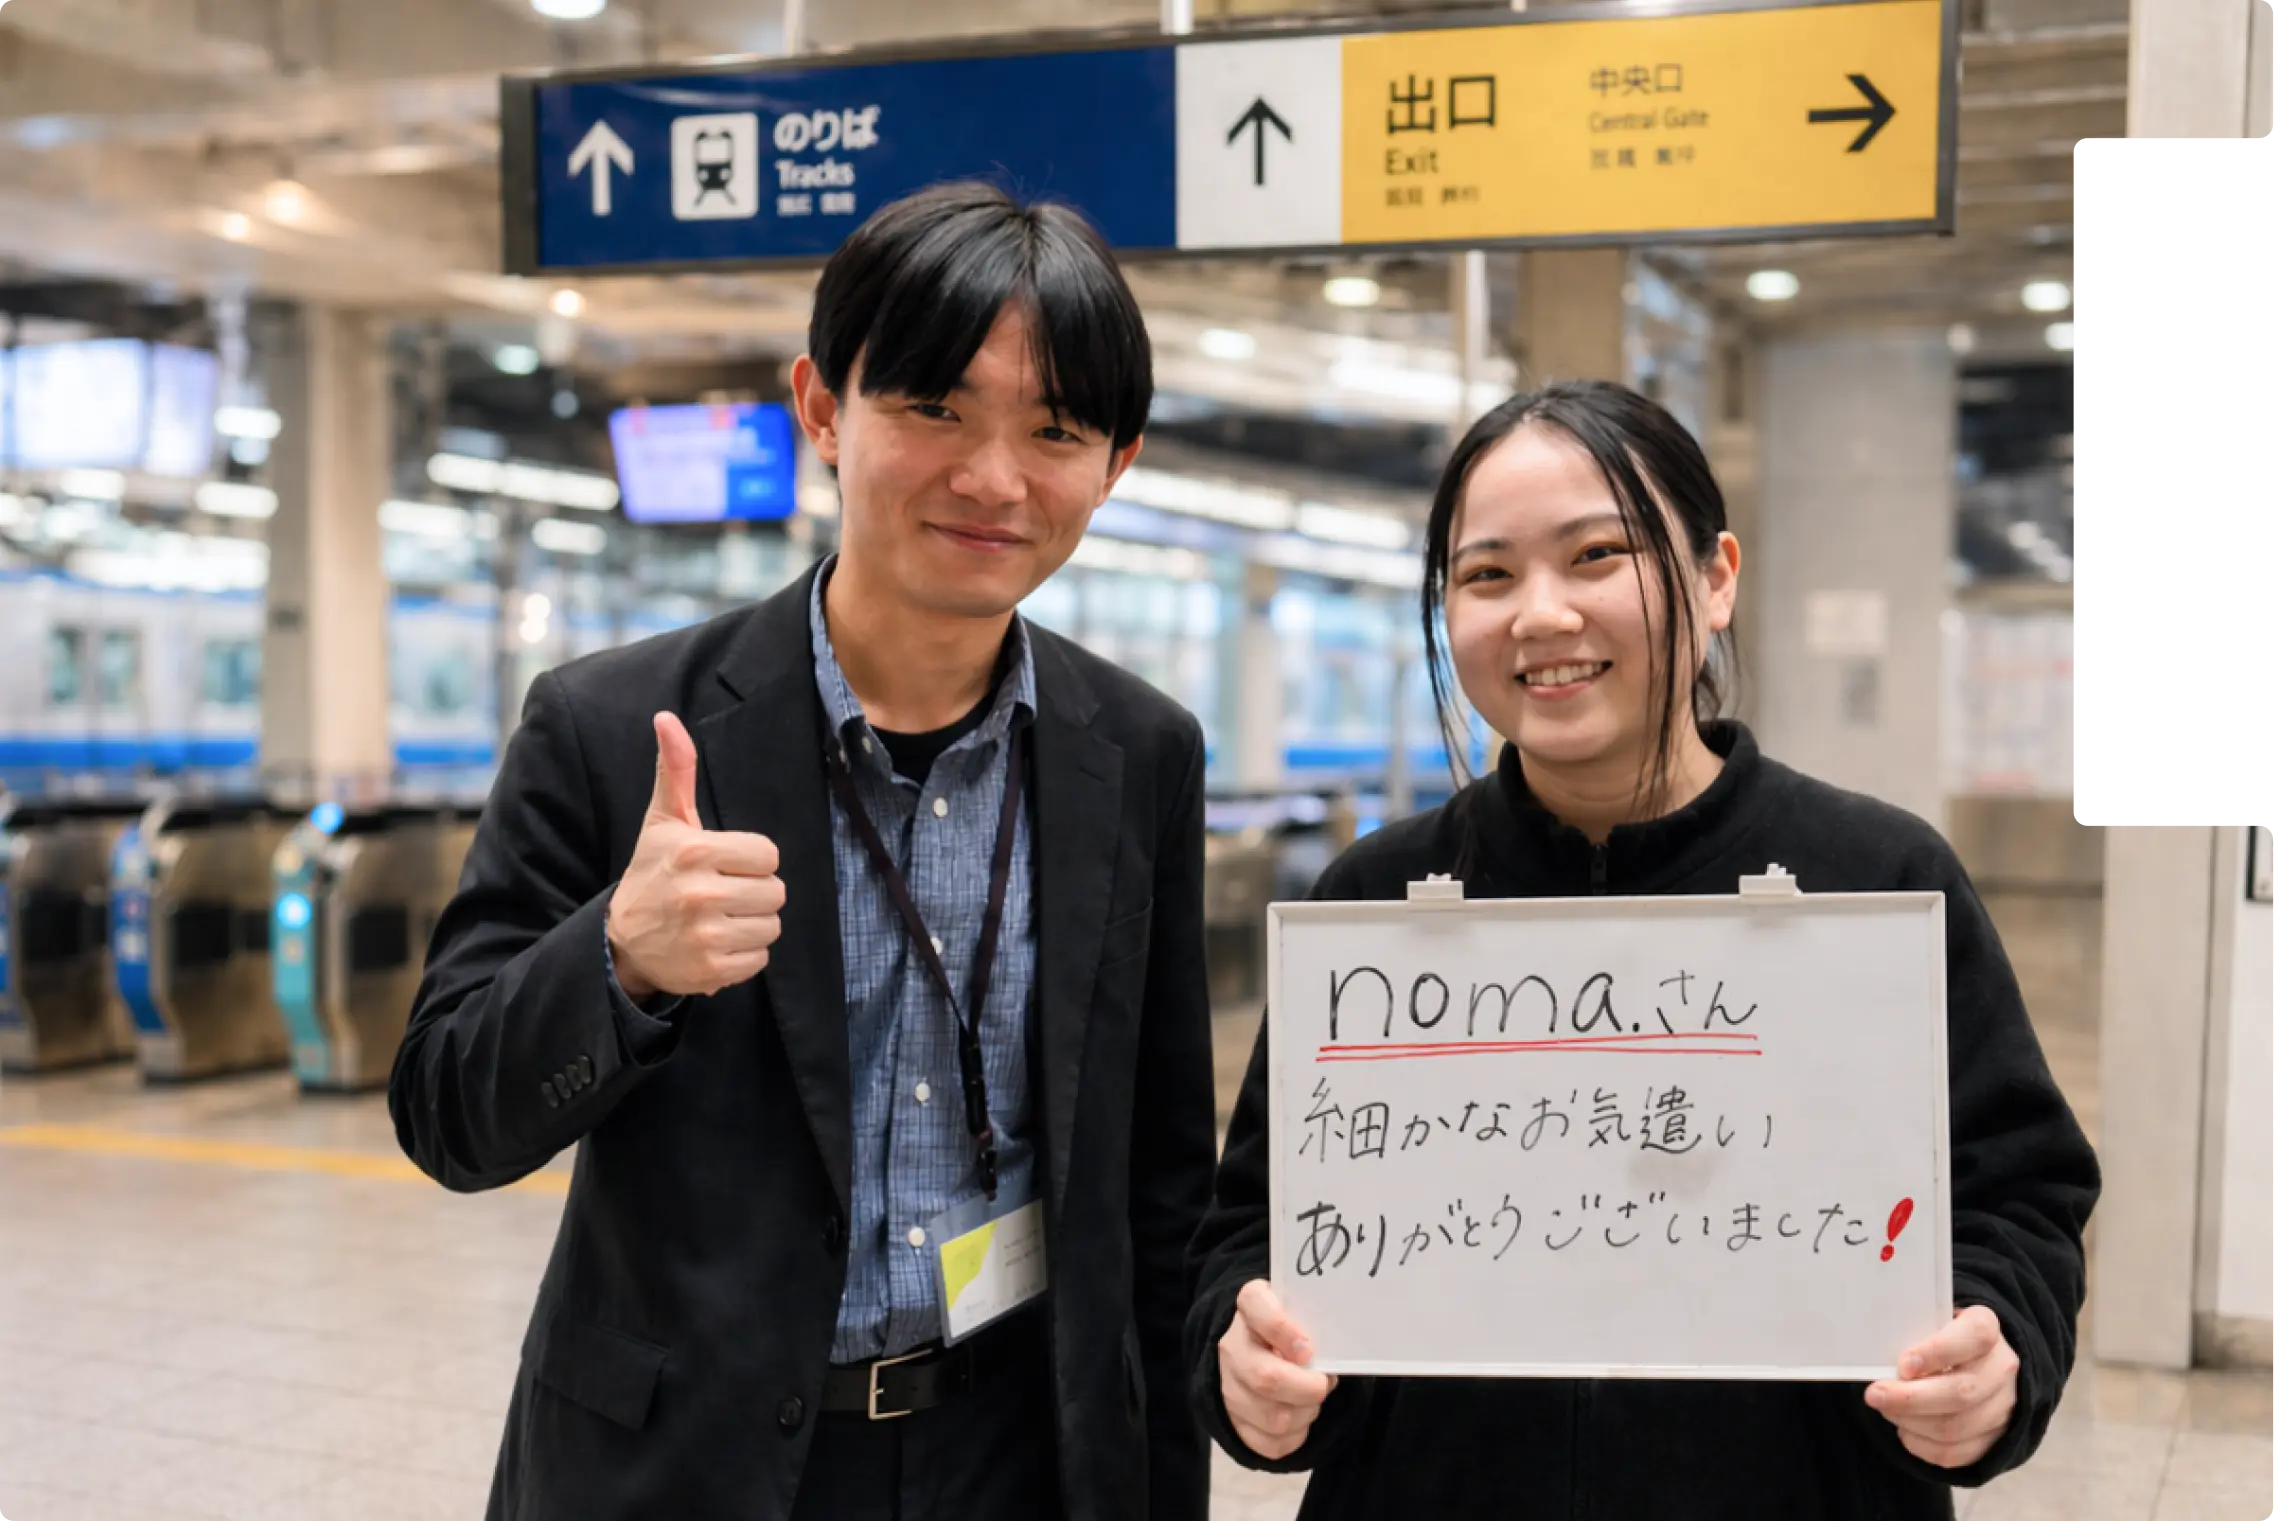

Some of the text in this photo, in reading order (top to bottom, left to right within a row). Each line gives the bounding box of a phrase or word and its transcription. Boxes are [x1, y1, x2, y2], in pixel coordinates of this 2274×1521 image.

[1590, 64, 1683, 98] 中央口
[1386, 74, 1496, 135] 出口
[1589, 107, 1658, 134] Central
[773, 105, 881, 153] のりば
[775, 157, 856, 190] Tracks
[1385, 146, 1439, 176] Exit
[1299, 1076, 1773, 1163] 細かなお気遣い
